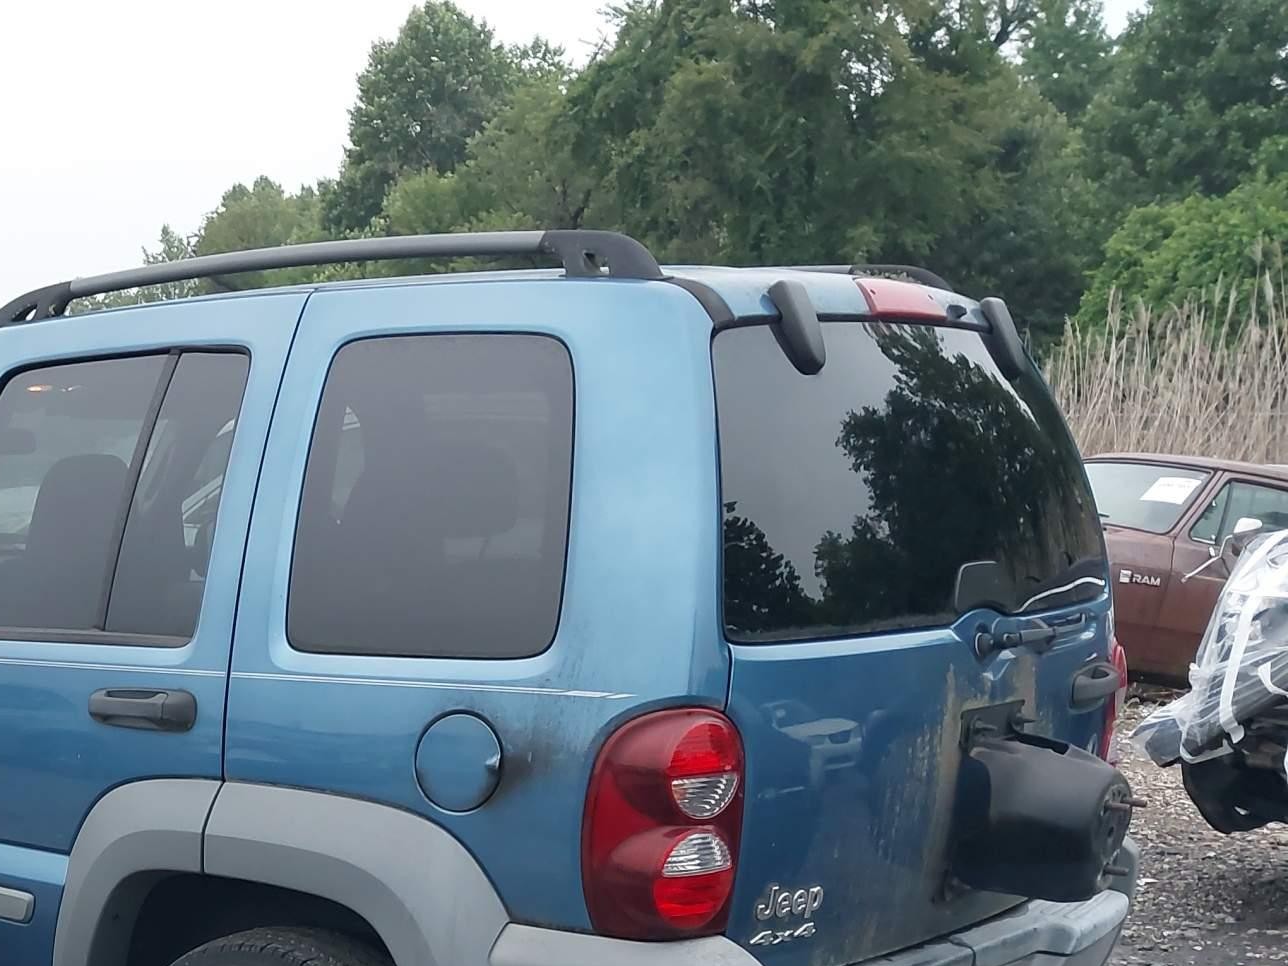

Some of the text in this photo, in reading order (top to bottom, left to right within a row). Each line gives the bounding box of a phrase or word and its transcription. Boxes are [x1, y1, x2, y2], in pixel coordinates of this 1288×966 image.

[1132, 574, 1161, 587] RAM
[755, 882, 824, 920] Jeep
[749, 921, 817, 946] 4x4
